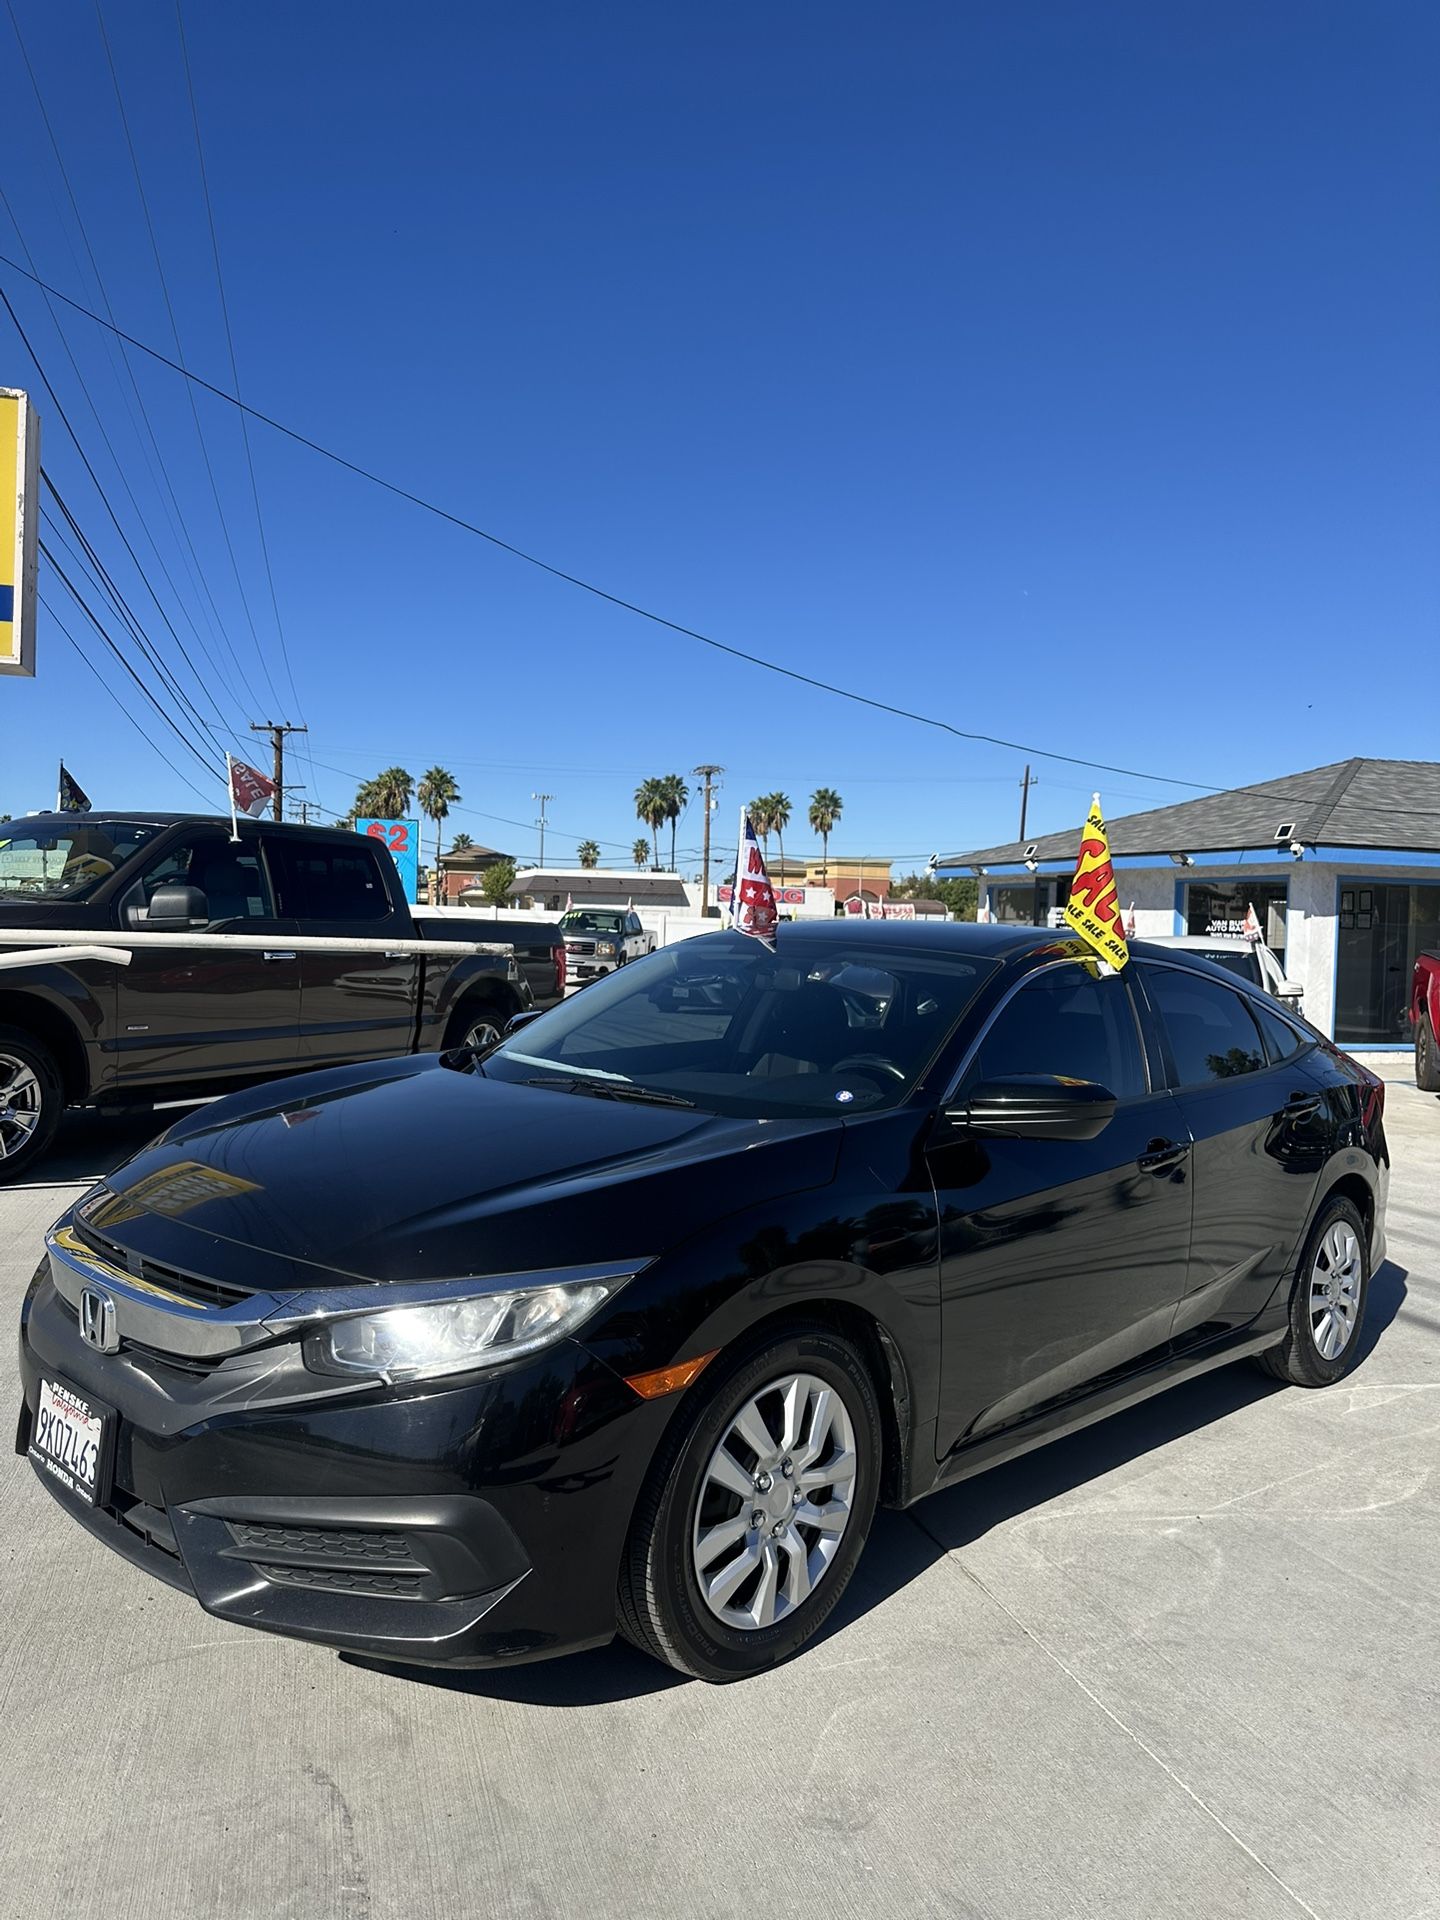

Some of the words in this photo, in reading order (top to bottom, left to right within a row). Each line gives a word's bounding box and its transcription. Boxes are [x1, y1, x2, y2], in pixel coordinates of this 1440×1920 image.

[366, 821, 408, 852] $2
[1068, 904, 1085, 919] ALE
[1082, 919, 1106, 940] SALE
[1105, 940, 1127, 960] SALE
[53, 1382, 90, 1414] PENSKE
[46, 1459, 74, 1489] HONDA
[75, 1483, 93, 1503] Ontario
